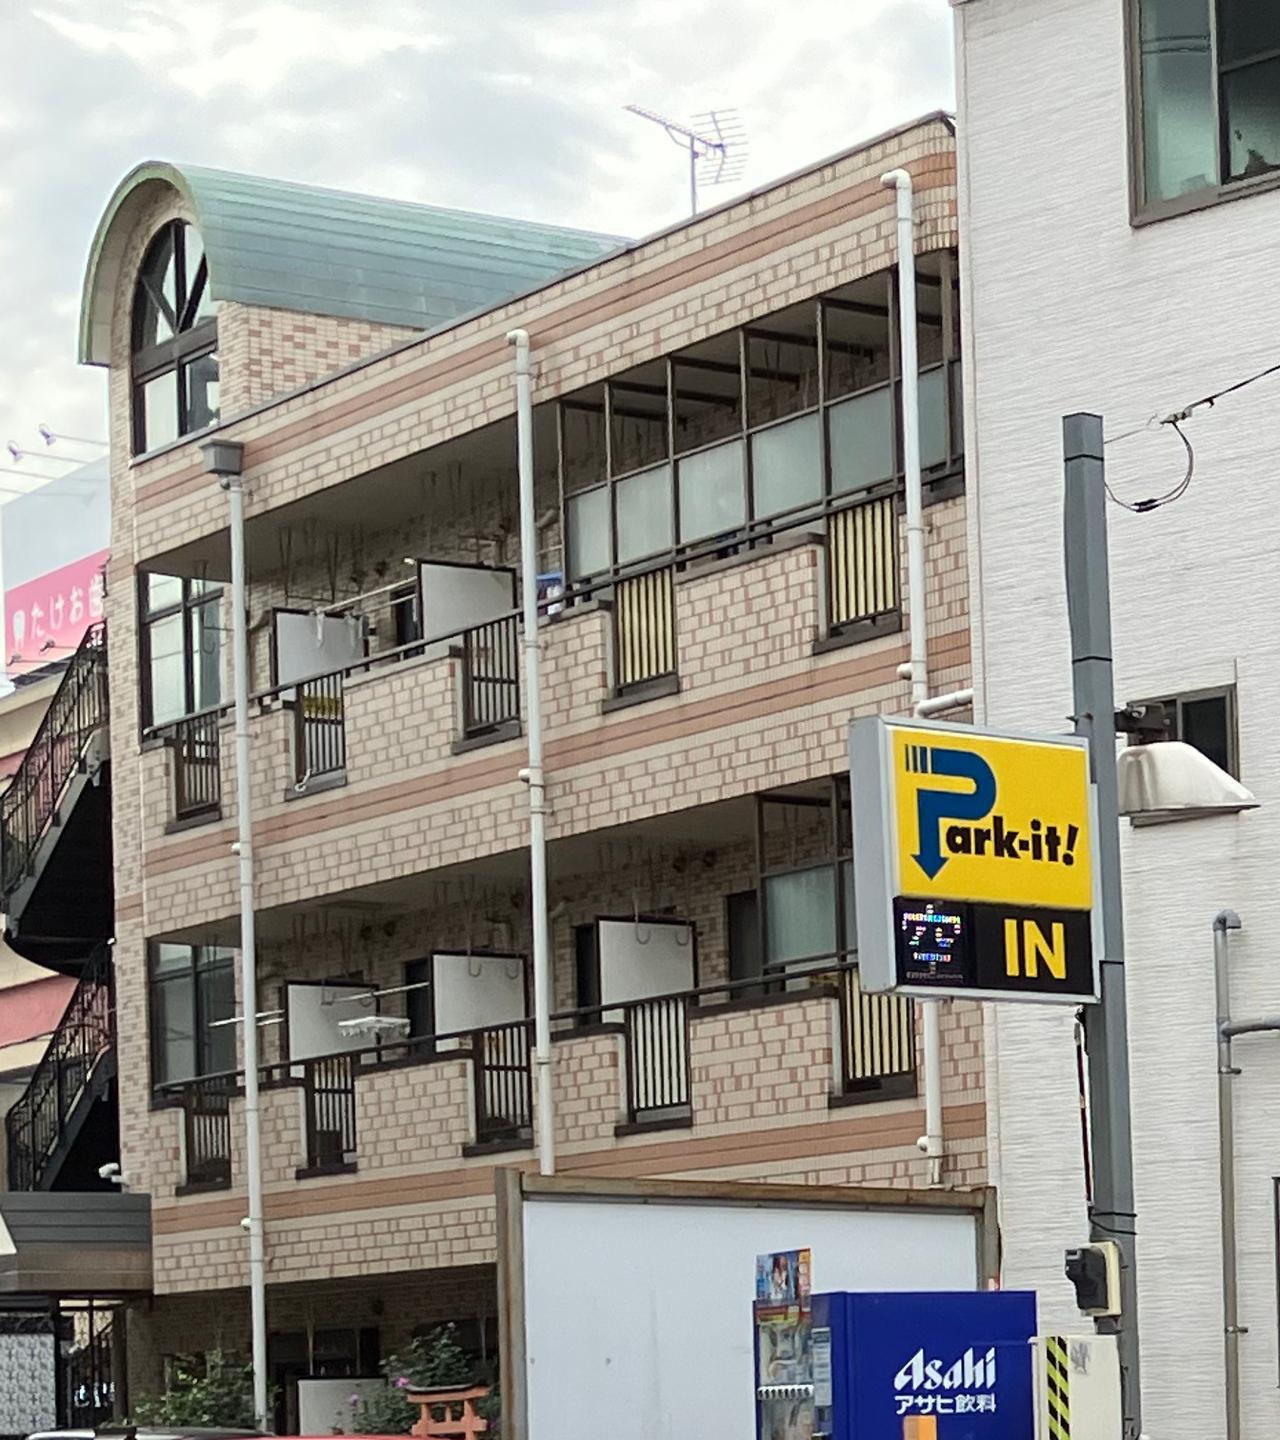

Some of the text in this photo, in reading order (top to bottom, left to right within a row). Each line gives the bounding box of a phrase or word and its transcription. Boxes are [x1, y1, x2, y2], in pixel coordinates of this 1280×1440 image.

[1004, 918, 1066, 979] IN
[894, 1347, 996, 1391] Asahi
[894, 1393, 996, 1415] アサヒ飲料
